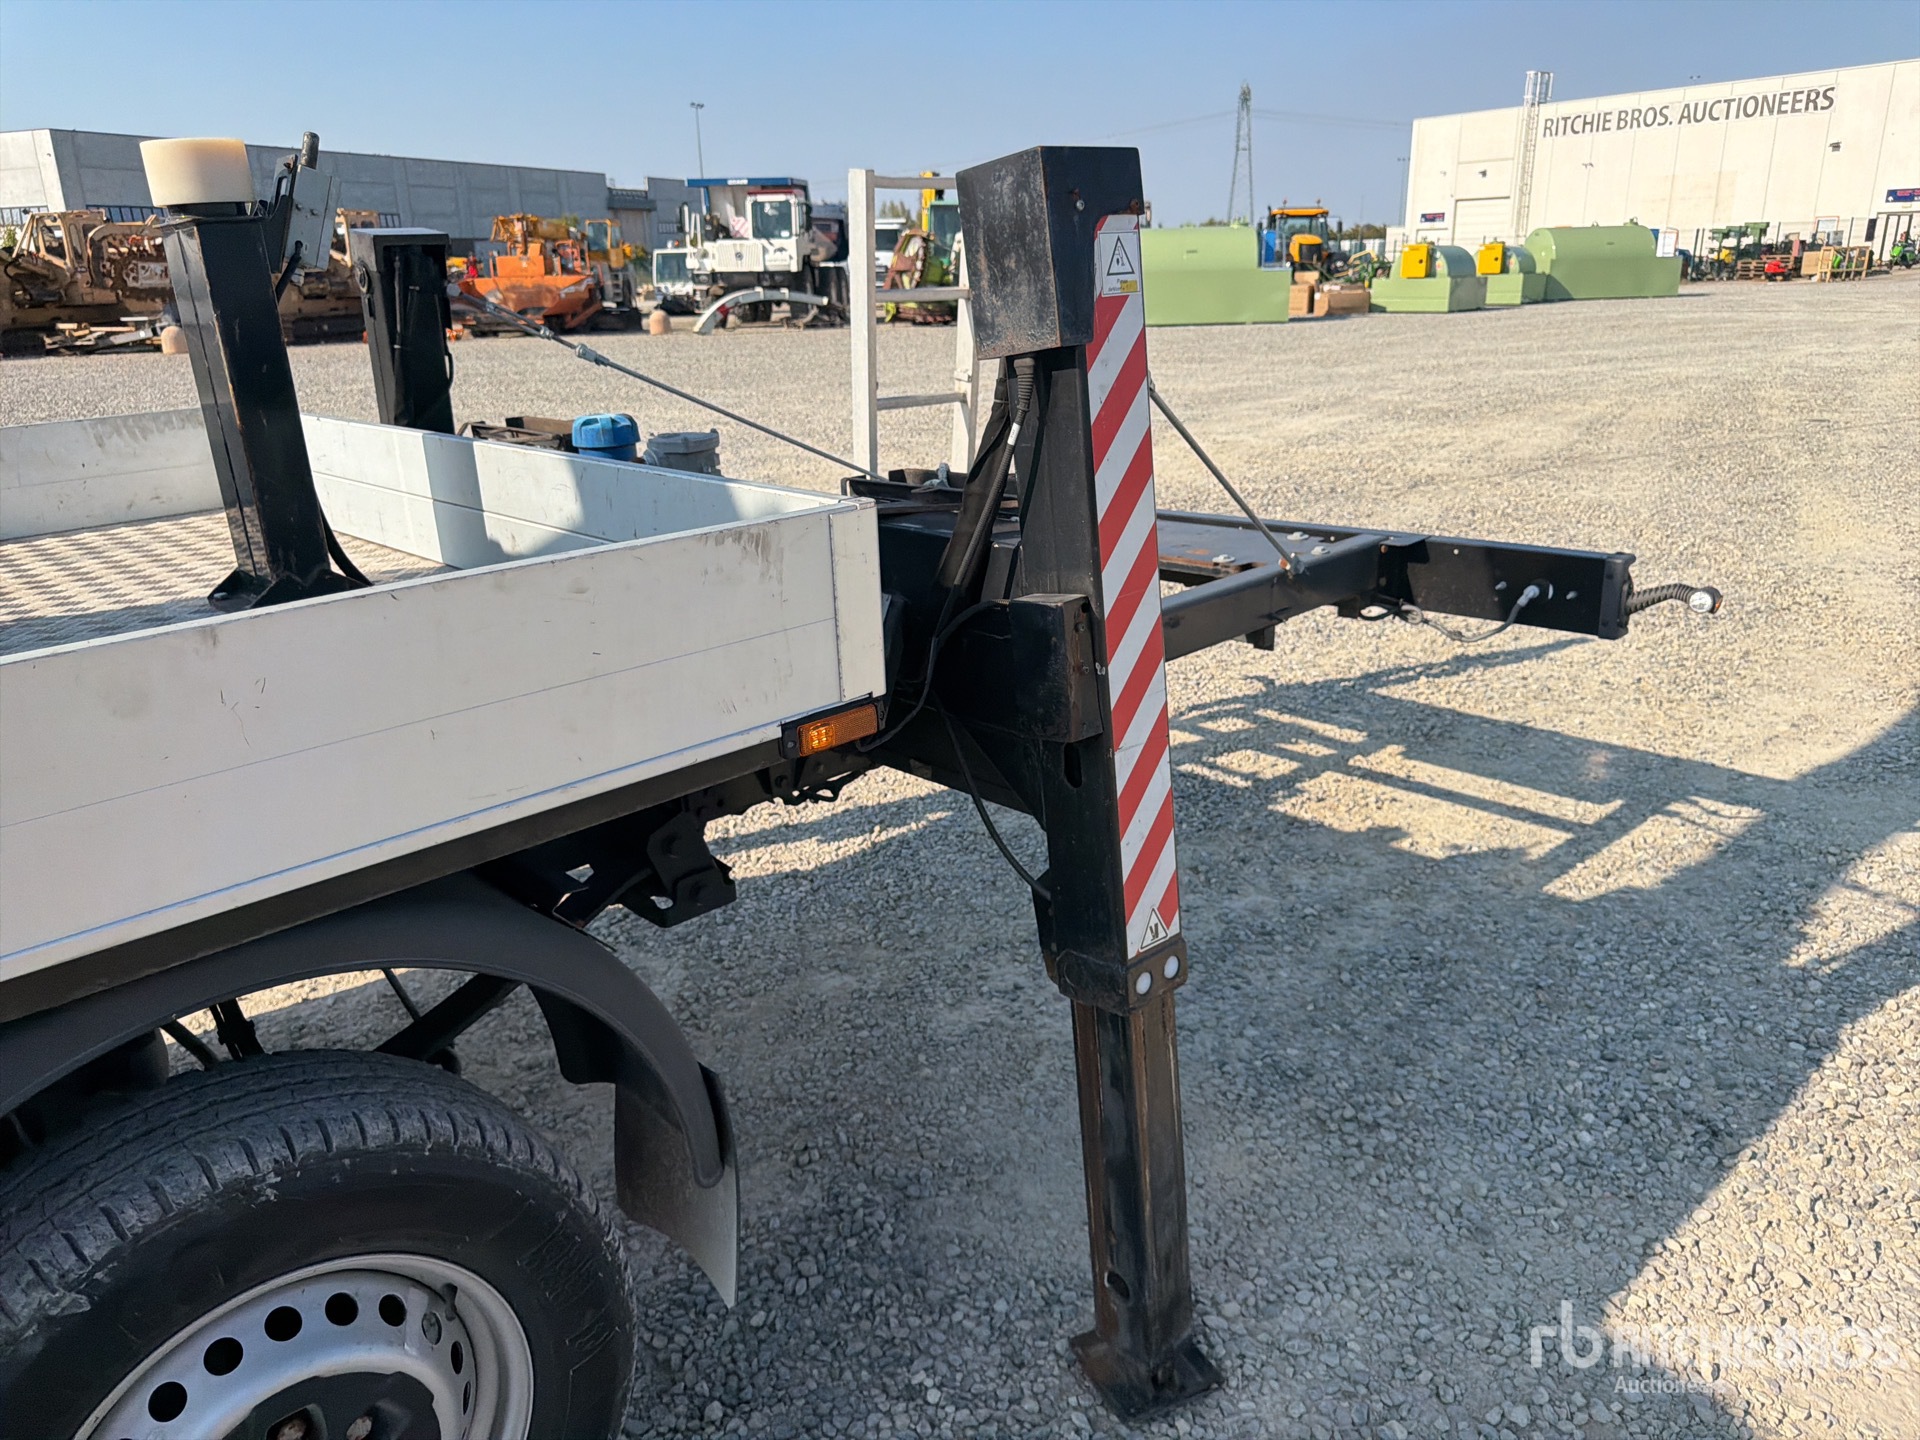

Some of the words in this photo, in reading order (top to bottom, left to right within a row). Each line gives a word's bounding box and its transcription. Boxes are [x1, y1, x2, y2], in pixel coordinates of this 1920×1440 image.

[1543, 111, 1612, 138] RITCHIE
[1616, 105, 1673, 130] BROS.
[1677, 86, 1836, 125] AUCTIONEERS
